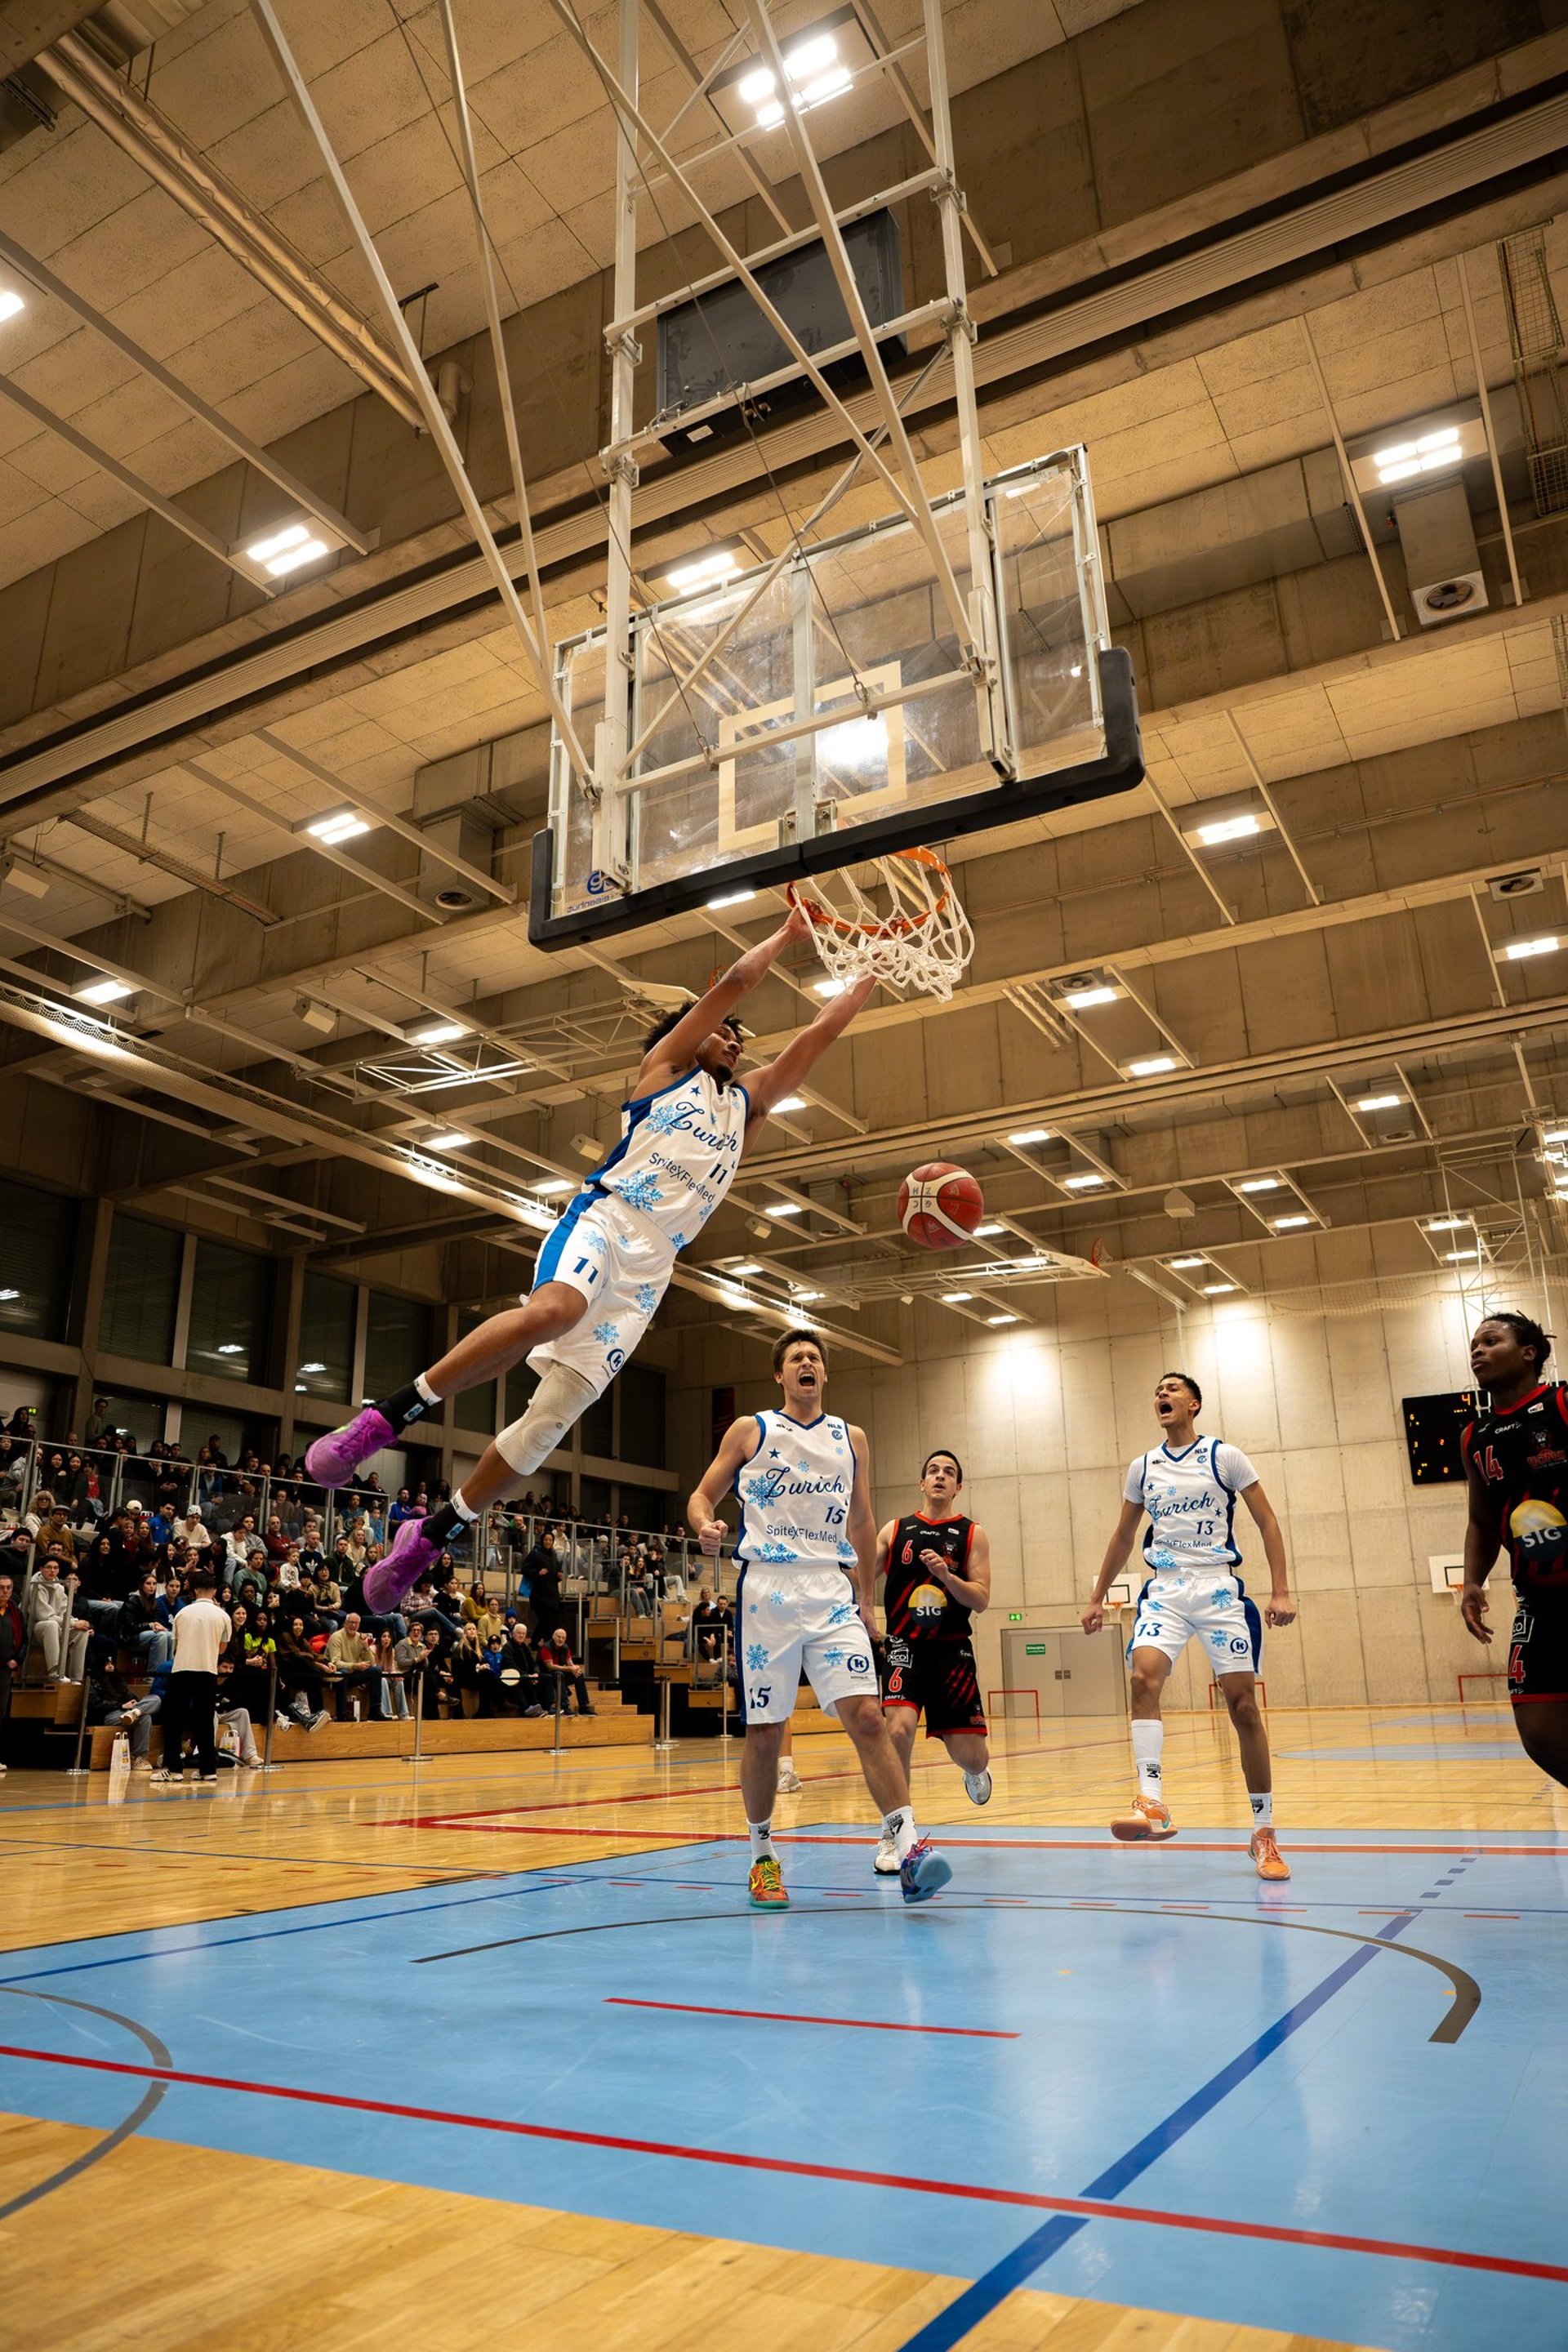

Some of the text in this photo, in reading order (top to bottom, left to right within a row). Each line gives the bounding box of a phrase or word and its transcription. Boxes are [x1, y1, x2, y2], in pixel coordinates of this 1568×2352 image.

[709, 1163, 728, 1185] 11
[573, 1256, 599, 1285] 11
[1462, 1393, 1471, 1405] 4
[1494, 1423, 1516, 1434] CRAFT
[1473, 1445, 1503, 1486] 14
[764, 1466, 844, 1499] Zurich
[825, 1506, 846, 1525] 15
[1149, 1491, 1215, 1520] Zurich
[1196, 1521, 1215, 1535] 13
[1522, 1528, 1562, 1548] SIG
[901, 1539, 913, 1565] 6
[915, 1606, 942, 1616] SIG
[1138, 1623, 1163, 1637] 13
[889, 1667, 903, 1693] 6
[750, 1686, 772, 1709] 15
